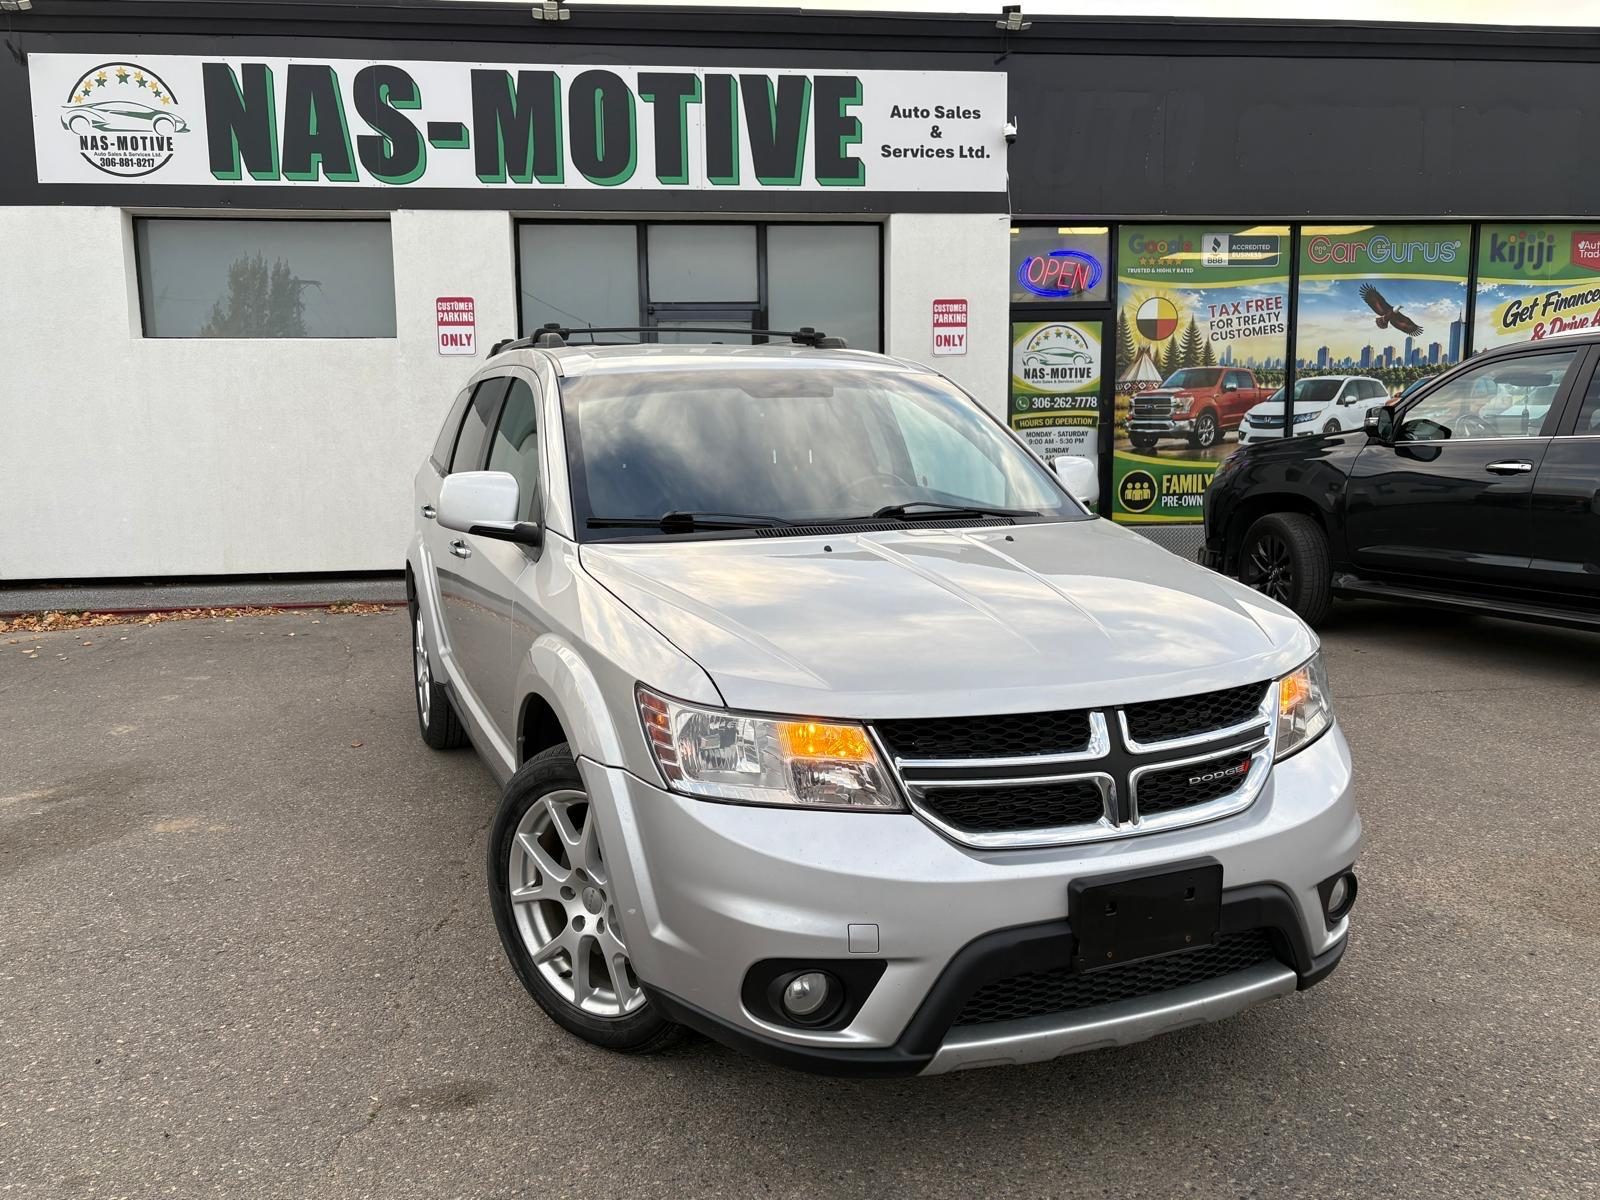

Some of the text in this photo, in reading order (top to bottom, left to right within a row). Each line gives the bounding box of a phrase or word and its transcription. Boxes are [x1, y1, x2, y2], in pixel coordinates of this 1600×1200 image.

[890, 105, 981, 119] Auto Sales
[202, 62, 865, 187] NAS-MOTIVE
[930, 125, 942, 138] &
[80, 135, 174, 151] NAS-MOTIVE
[881, 144, 990, 158] Services Ltd.
[100, 157, 155, 168] 306-881-8217
[1490, 231, 1556, 270] kijiji
[1578, 249, 1600, 258] Trad
[1027, 256, 1090, 290] OPEN
[437, 302, 473, 311] CUSTOMER
[934, 303, 967, 312] CUSTOMER
[1208, 296, 1283, 318] TAX FREE
[1502, 297, 1540, 328] Get
[438, 311, 474, 322] PARKING
[934, 313, 967, 324] PARKING
[1210, 311, 1281, 331] FOR TREATY
[1549, 315, 1589, 335] Drive
[1210, 323, 1285, 342] CUSTOMERS
[441, 333, 472, 347] ONLY
[936, 334, 964, 347] ONLY
[1023, 367, 1092, 380] NAS-MOTIVE
[1032, 396, 1098, 409] 306-262-7778
[1019, 418, 1043, 428] HOURS
[1055, 417, 1093, 426] OPERATION
[1162, 473, 1214, 494] FAMILY
[1161, 495, 1204, 508] PRE-OWN
[1188, 764, 1245, 785] DODGE
